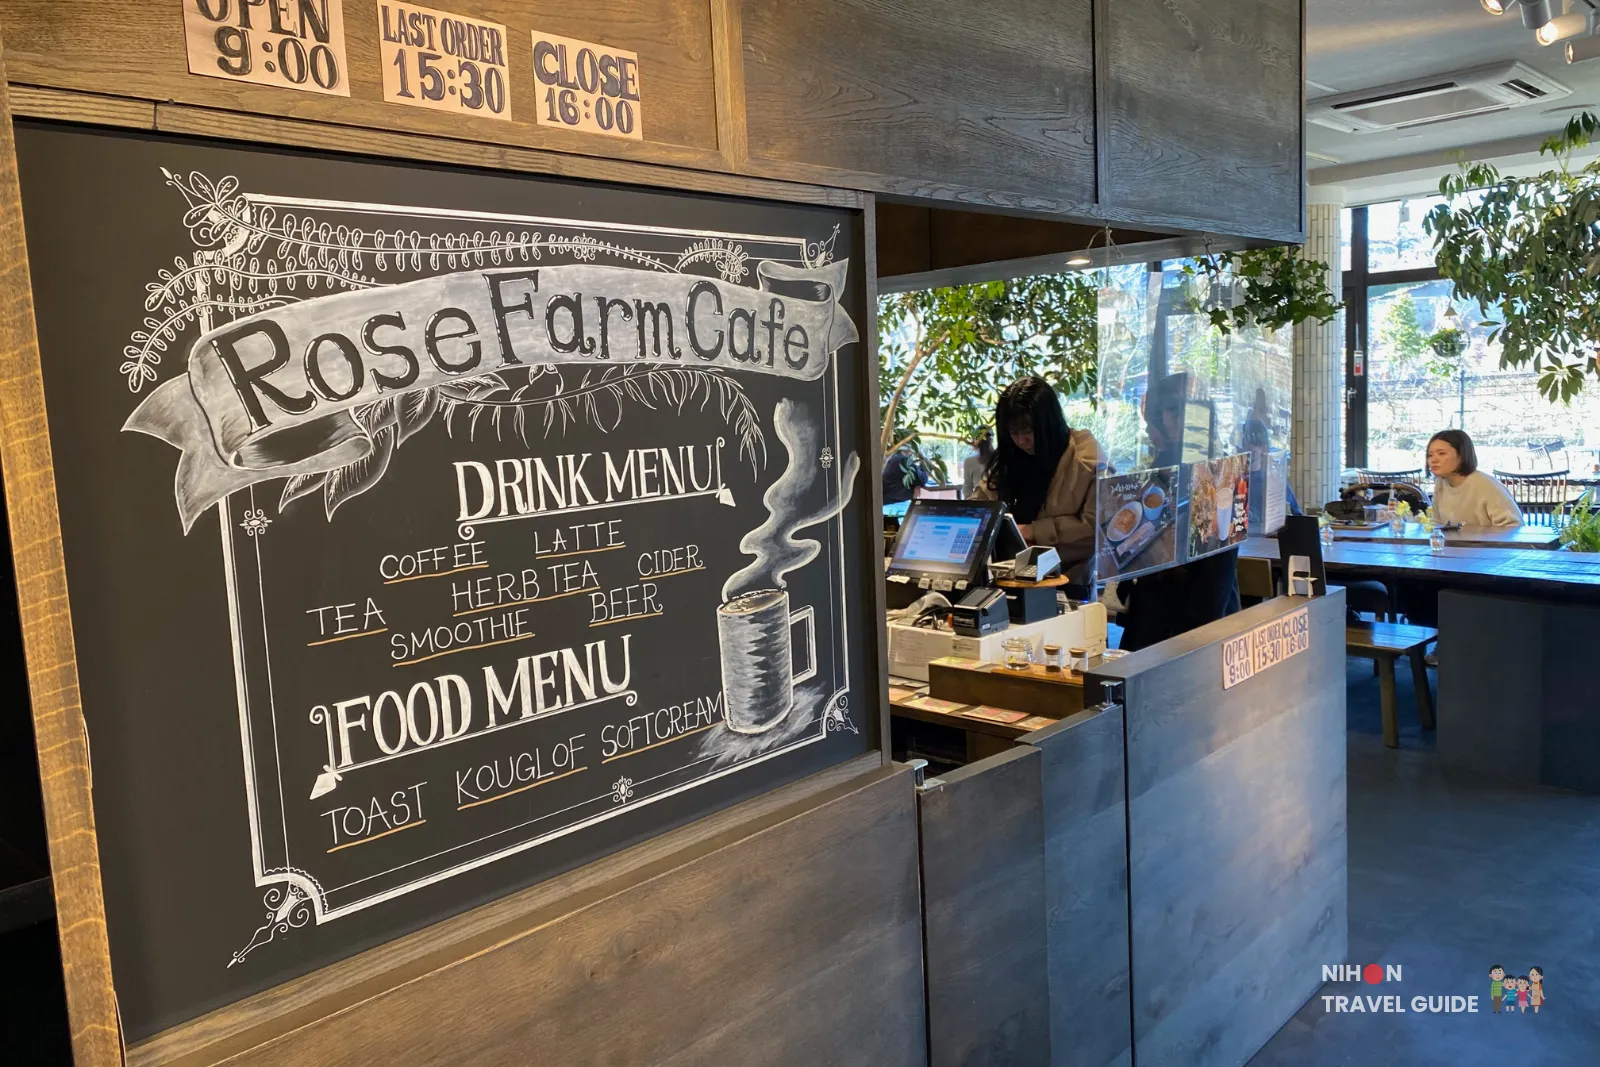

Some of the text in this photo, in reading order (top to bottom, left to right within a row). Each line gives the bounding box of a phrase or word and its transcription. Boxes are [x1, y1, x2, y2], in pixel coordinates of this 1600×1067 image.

[214, 26, 340, 90] 9:00
[381, 5, 506, 67] LAST ORDER
[393, 48, 506, 114] 15:30
[533, 41, 640, 102] CLOSE
[545, 87, 634, 134] 16:00
[211, 269, 811, 434] Rose Farm Cafe
[452, 444, 714, 522] DRINK MENU
[379, 519, 626, 580] COFFEE LATTE
[306, 545, 704, 636] TEA HERB TEA CIDER
[390, 582, 663, 660] SMOOTHIE BEER
[1224, 636, 1250, 667] OPEN
[1283, 613, 1308, 639] CLOSE
[332, 634, 633, 769] FOOD MENU
[1229, 659, 1251, 684] 9:00
[320, 691, 726, 845] TOAST KOUGLOF SOFTCREAM
